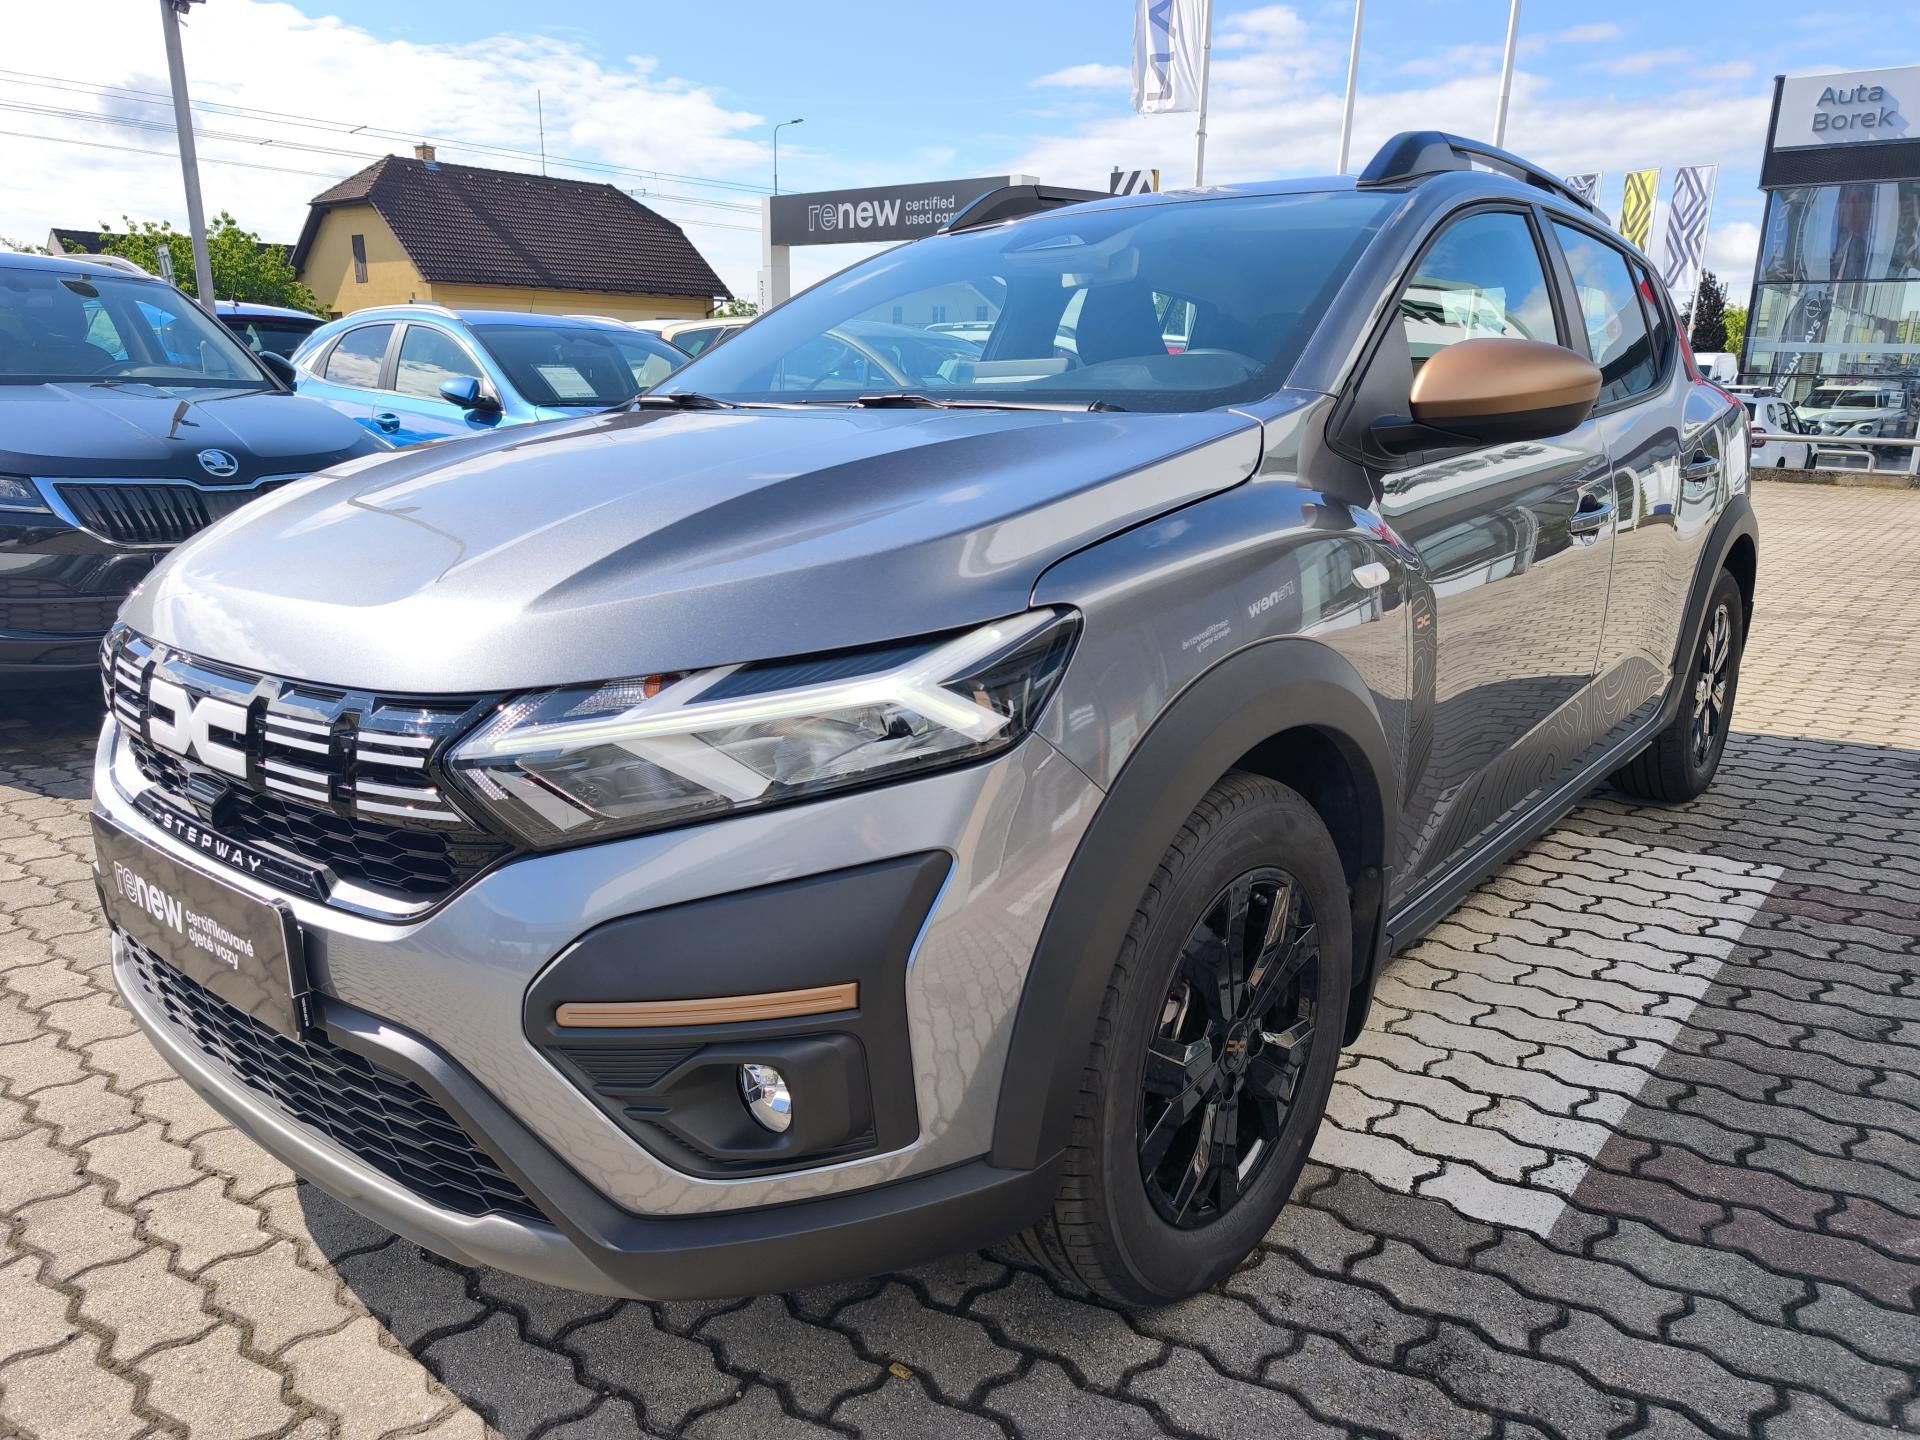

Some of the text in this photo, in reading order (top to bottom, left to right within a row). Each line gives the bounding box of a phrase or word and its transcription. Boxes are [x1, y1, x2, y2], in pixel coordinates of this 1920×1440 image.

[1815, 84, 1884, 107] Auta
[1811, 106, 1894, 132] Borek
[808, 199, 901, 232] renew
[905, 194, 955, 211] certified
[905, 210, 958, 225] used car
[163, 813, 261, 871] STEPWAY
[113, 860, 183, 933] renew
[186, 909, 254, 957] certifikované
[188, 927, 239, 970] ojeté vozy
